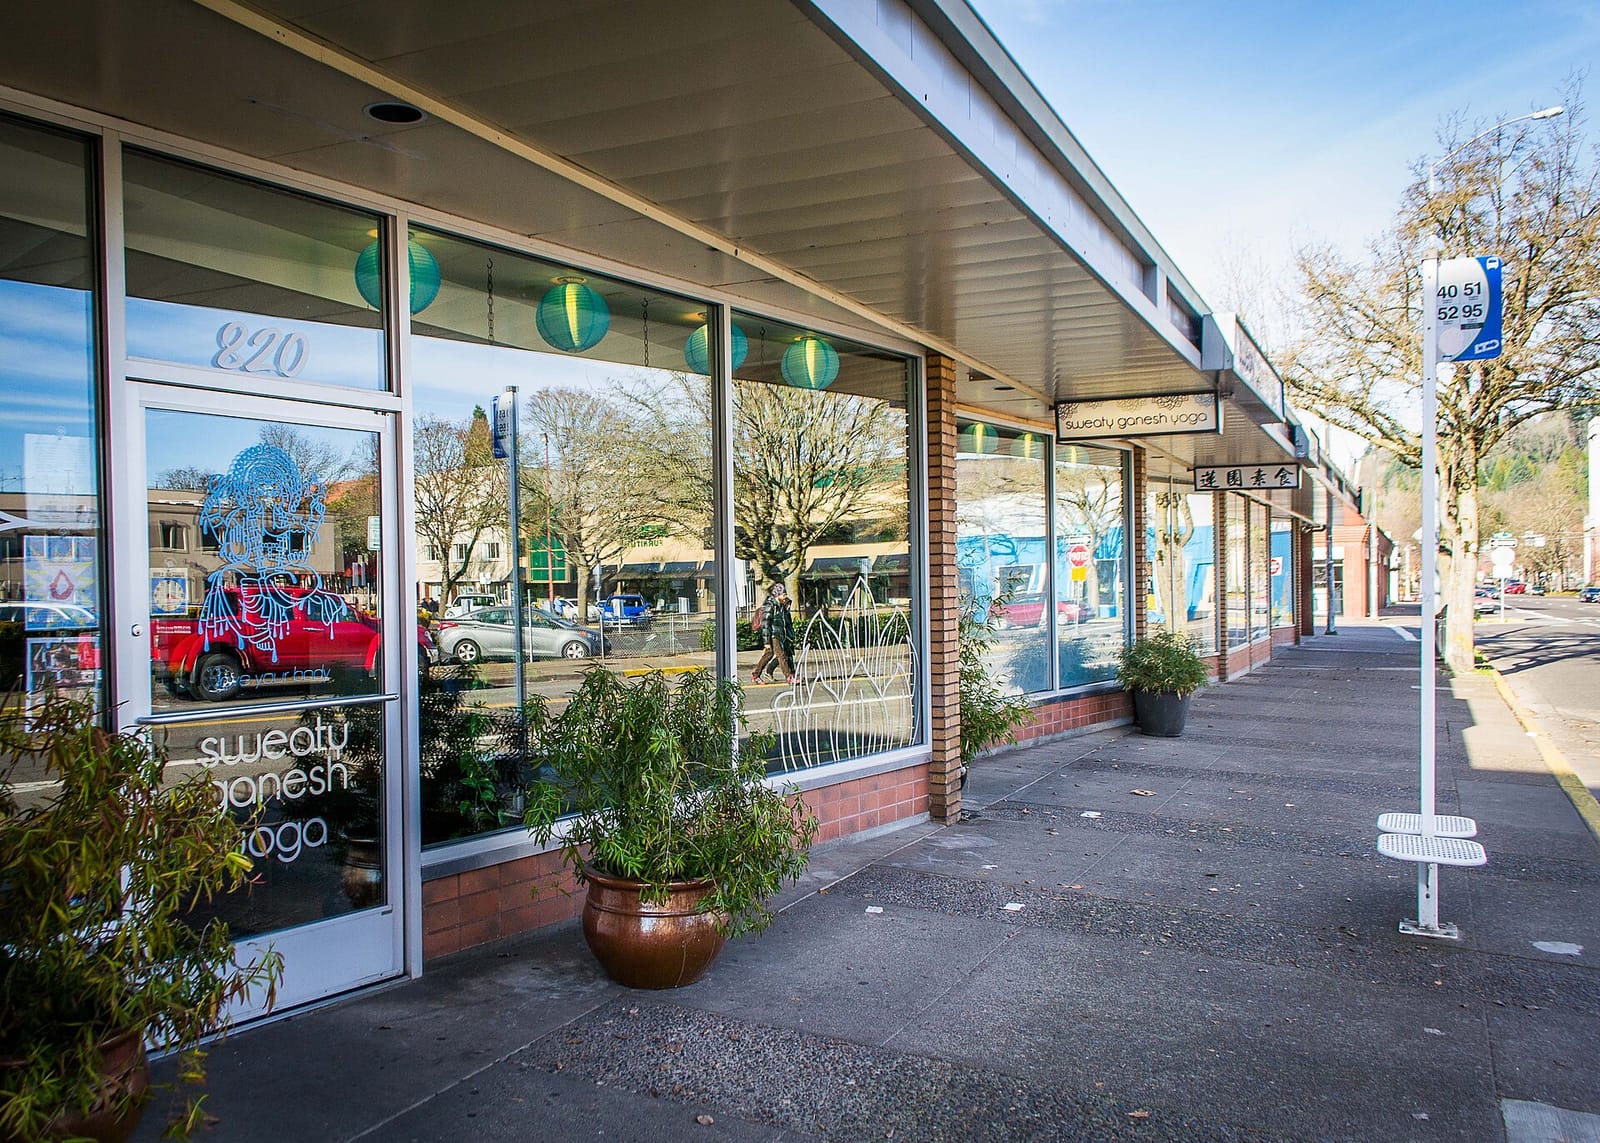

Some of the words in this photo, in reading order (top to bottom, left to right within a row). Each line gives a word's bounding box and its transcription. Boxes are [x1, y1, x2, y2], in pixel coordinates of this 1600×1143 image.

[1437, 285, 1458, 298] 40
[1463, 282, 1481, 296] 51
[1438, 306, 1459, 320] 52
[1462, 304, 1483, 318] 95
[211, 321, 310, 377] 820
[1065, 416, 1114, 430] sweaty
[1117, 413, 1168, 429] ganesh
[1171, 412, 1208, 425] yoga
[255, 671, 290, 688] your
[293, 664, 331, 684] body
[200, 716, 349, 768] sweaty
[240, 817, 328, 863] oga
